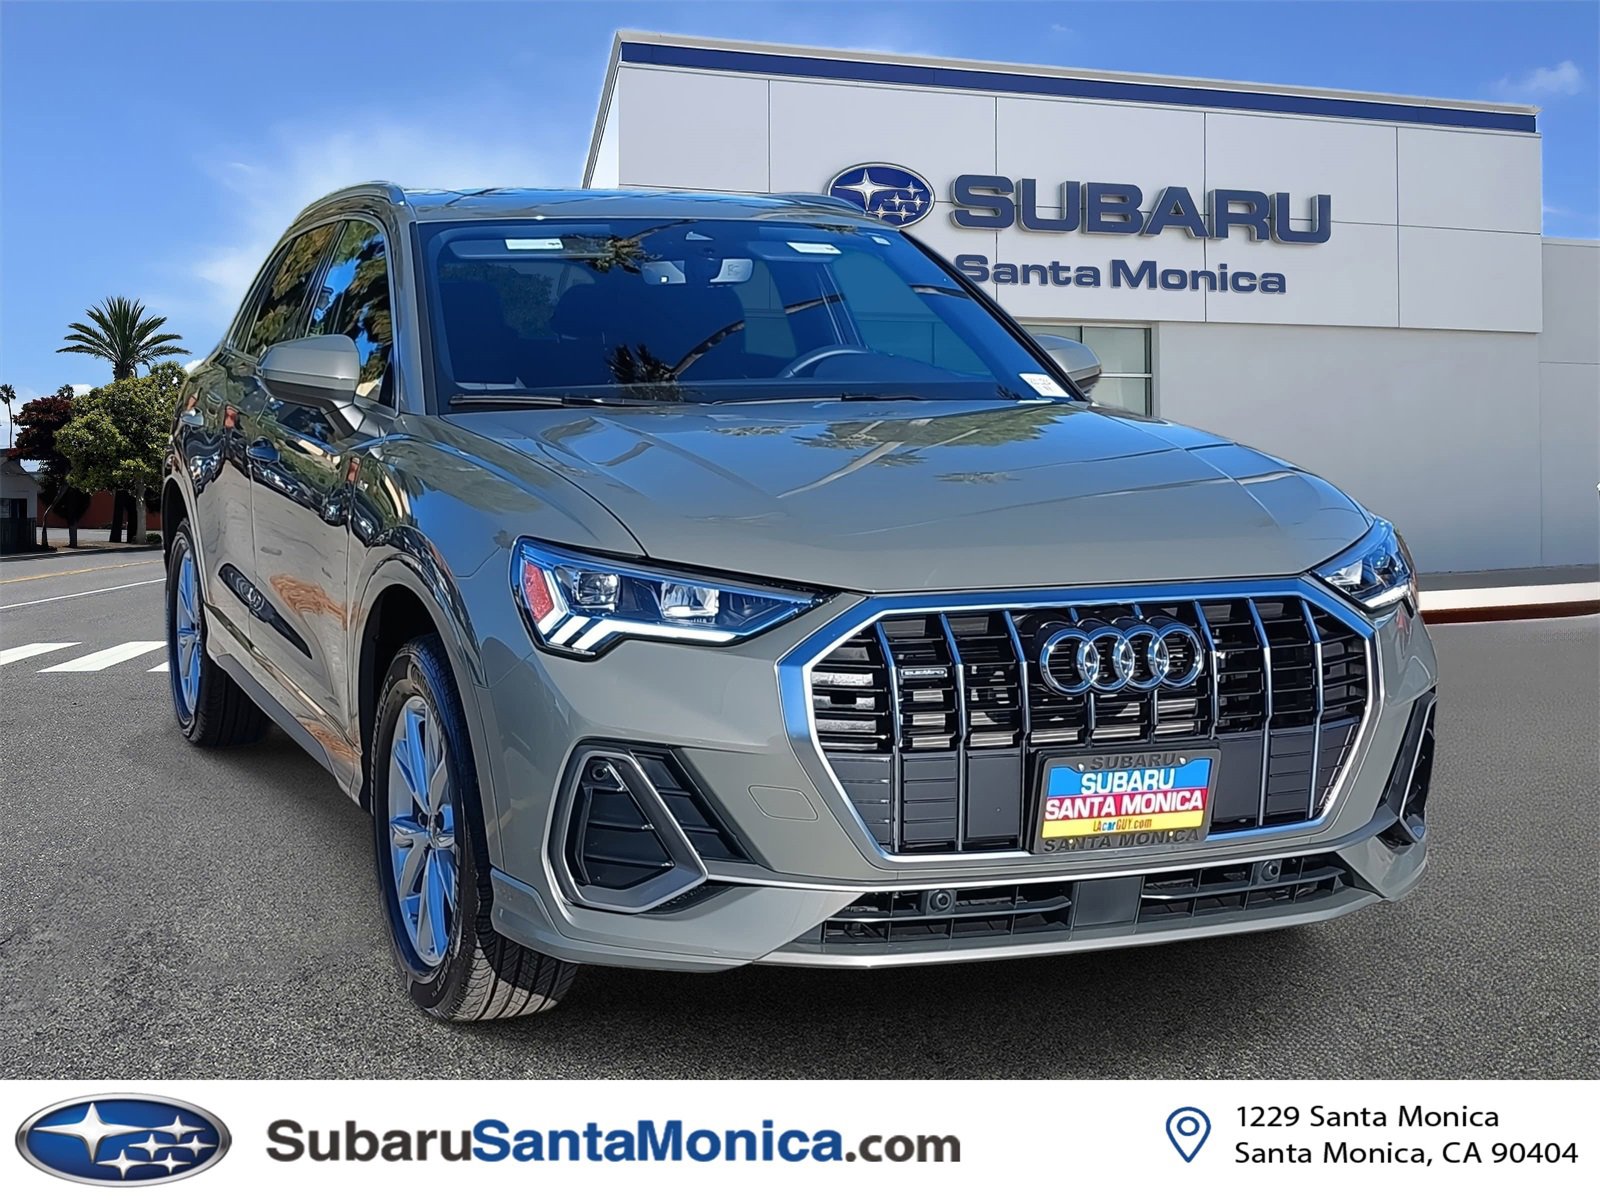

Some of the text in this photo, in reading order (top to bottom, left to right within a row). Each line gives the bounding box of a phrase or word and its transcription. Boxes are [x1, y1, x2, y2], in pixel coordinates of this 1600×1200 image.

[950, 173, 1332, 245] SUBARU
[954, 254, 1287, 294] Santa Monica
[1090, 753, 1176, 770] SUBARU
[1080, 768, 1176, 795] SUBARU
[1045, 790, 1204, 820] SANTA MONICA
[1093, 817, 1152, 832] LAcarGUY.com
[1044, 828, 1199, 853] SANTA MONICA
